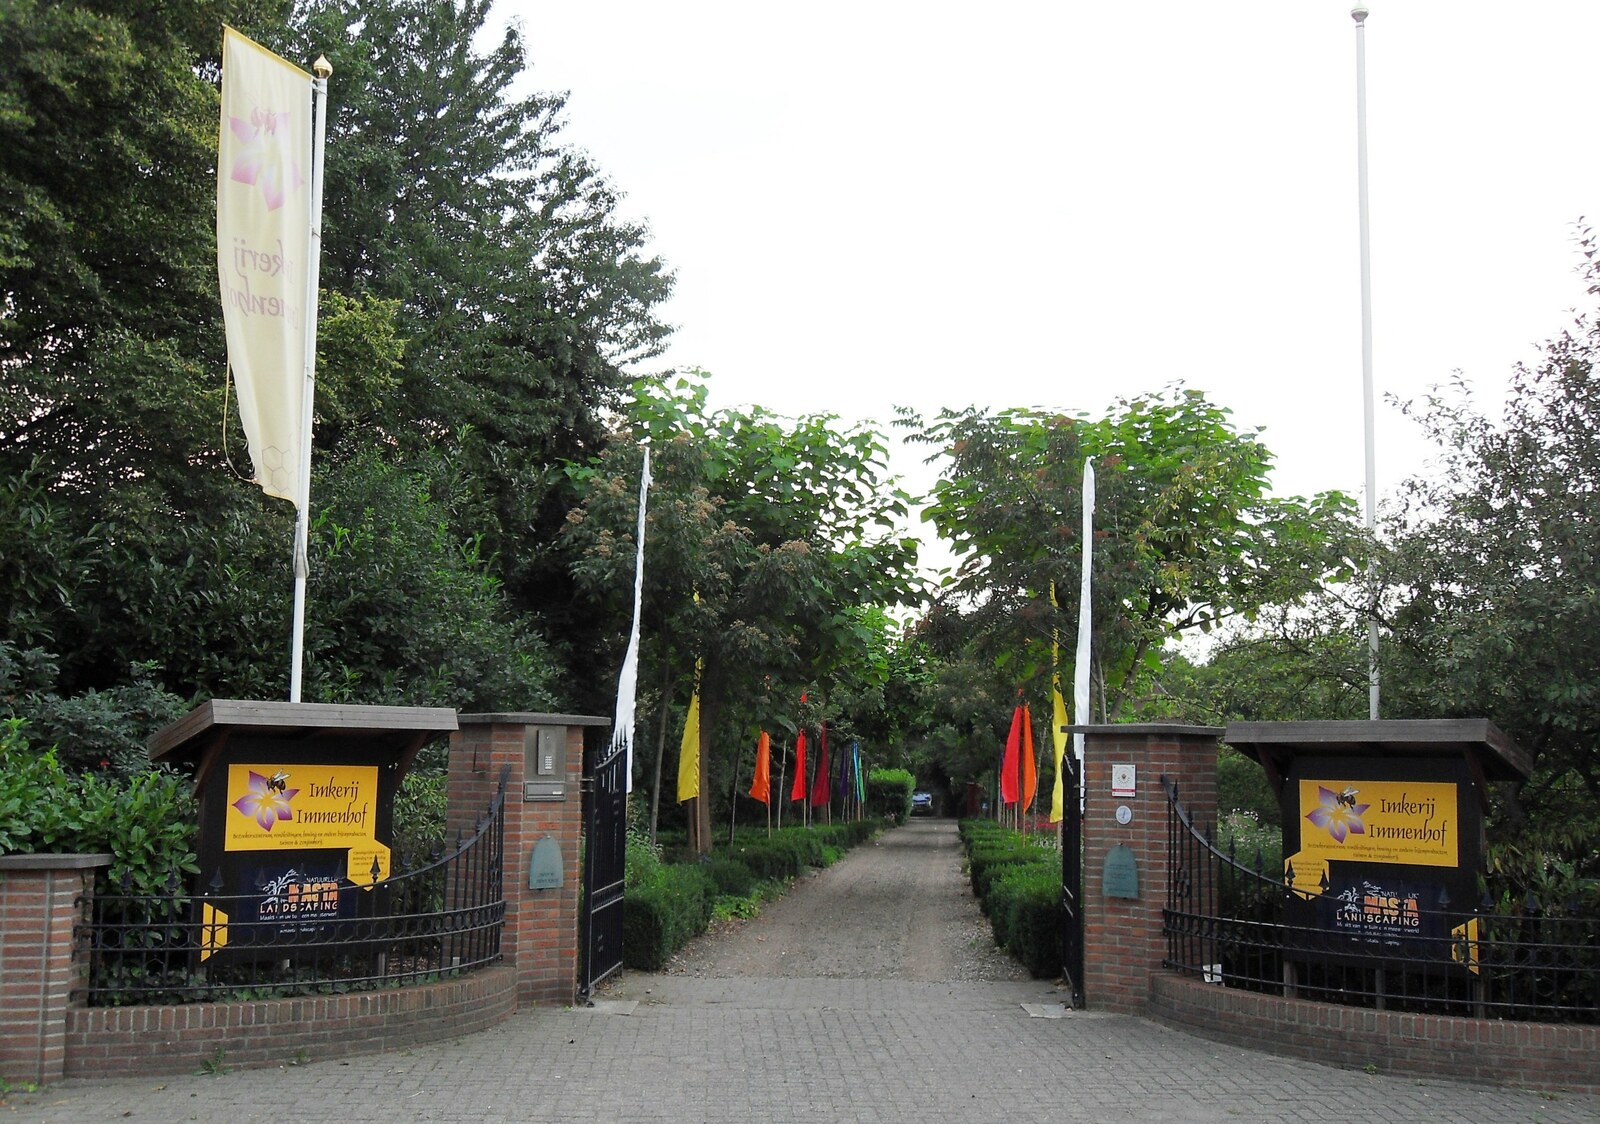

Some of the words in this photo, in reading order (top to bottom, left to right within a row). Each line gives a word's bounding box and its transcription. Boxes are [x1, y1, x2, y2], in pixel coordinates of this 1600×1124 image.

[310, 777, 359, 802] Imkerij
[296, 802, 368, 829] Immenhof
[1380, 793, 1435, 819] Imkerij
[1368, 819, 1447, 847] Immenhof
